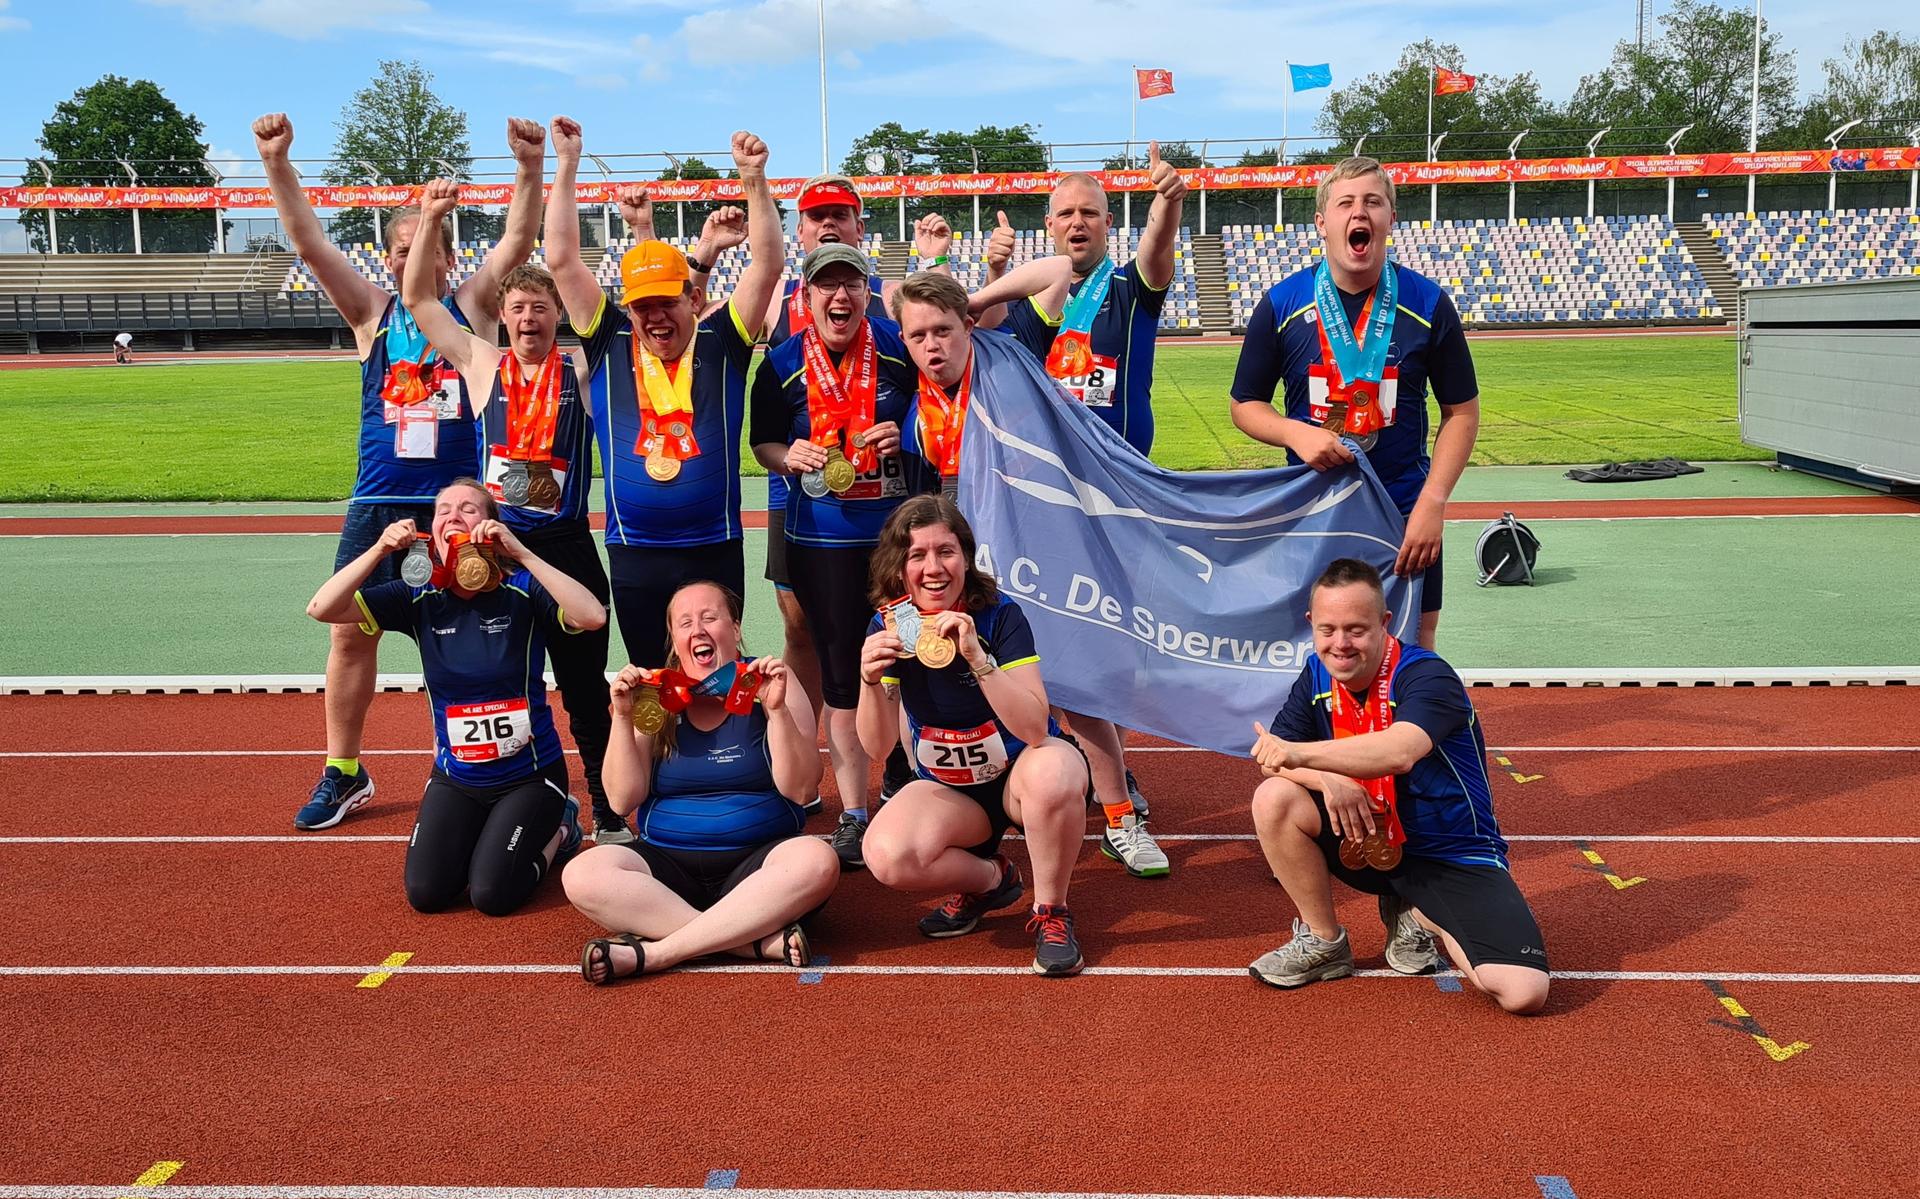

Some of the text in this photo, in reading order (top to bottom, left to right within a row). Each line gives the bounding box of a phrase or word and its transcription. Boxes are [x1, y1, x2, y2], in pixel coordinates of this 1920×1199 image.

[1417, 167, 1442, 178] ALTIJD
[1455, 164, 1499, 176] WINNAAR!
[1521, 164, 1546, 176] ALTIJD
[1560, 162, 1606, 174] WINNAAR!
[914, 180, 938, 190] ALTIJD
[951, 178, 994, 189] WINNAAR!
[1112, 174, 1136, 184] ALTIJD
[1214, 174, 1238, 184] ALTIJD
[1251, 172, 1294, 182] WINNAAR!
[658, 185, 700, 196] WINNAAR!
[716, 184, 741, 195] ALTIJD
[1012, 180, 1036, 190] ALTIJD
[17, 192, 44, 204] ALTIJD
[58, 192, 104, 202] WINNAAR!
[124, 192, 150, 204] ALTIJD
[164, 191, 208, 202] WINNAAR!
[228, 193, 254, 204] ALTIJD
[330, 192, 355, 204] ALTIJD
[368, 192, 409, 202] WINNAAR!
[1323, 280, 1352, 346] OLYMPICS NATIONALE
[1374, 308, 1388, 338] ALTIJD
[1382, 290, 1392, 308] EEN
[864, 344, 872, 361] EEN
[860, 362, 871, 389] ALTIJD
[1066, 573, 1124, 623] De
[1378, 680, 1388, 699] EEN
[484, 702, 508, 712] SPECIAL!
[1380, 702, 1388, 729] LTIJD
[464, 716, 514, 742] 216
[956, 730, 981, 740] SPECIAL!
[933, 743, 988, 767] 215
[507, 826, 523, 850] FUSION
